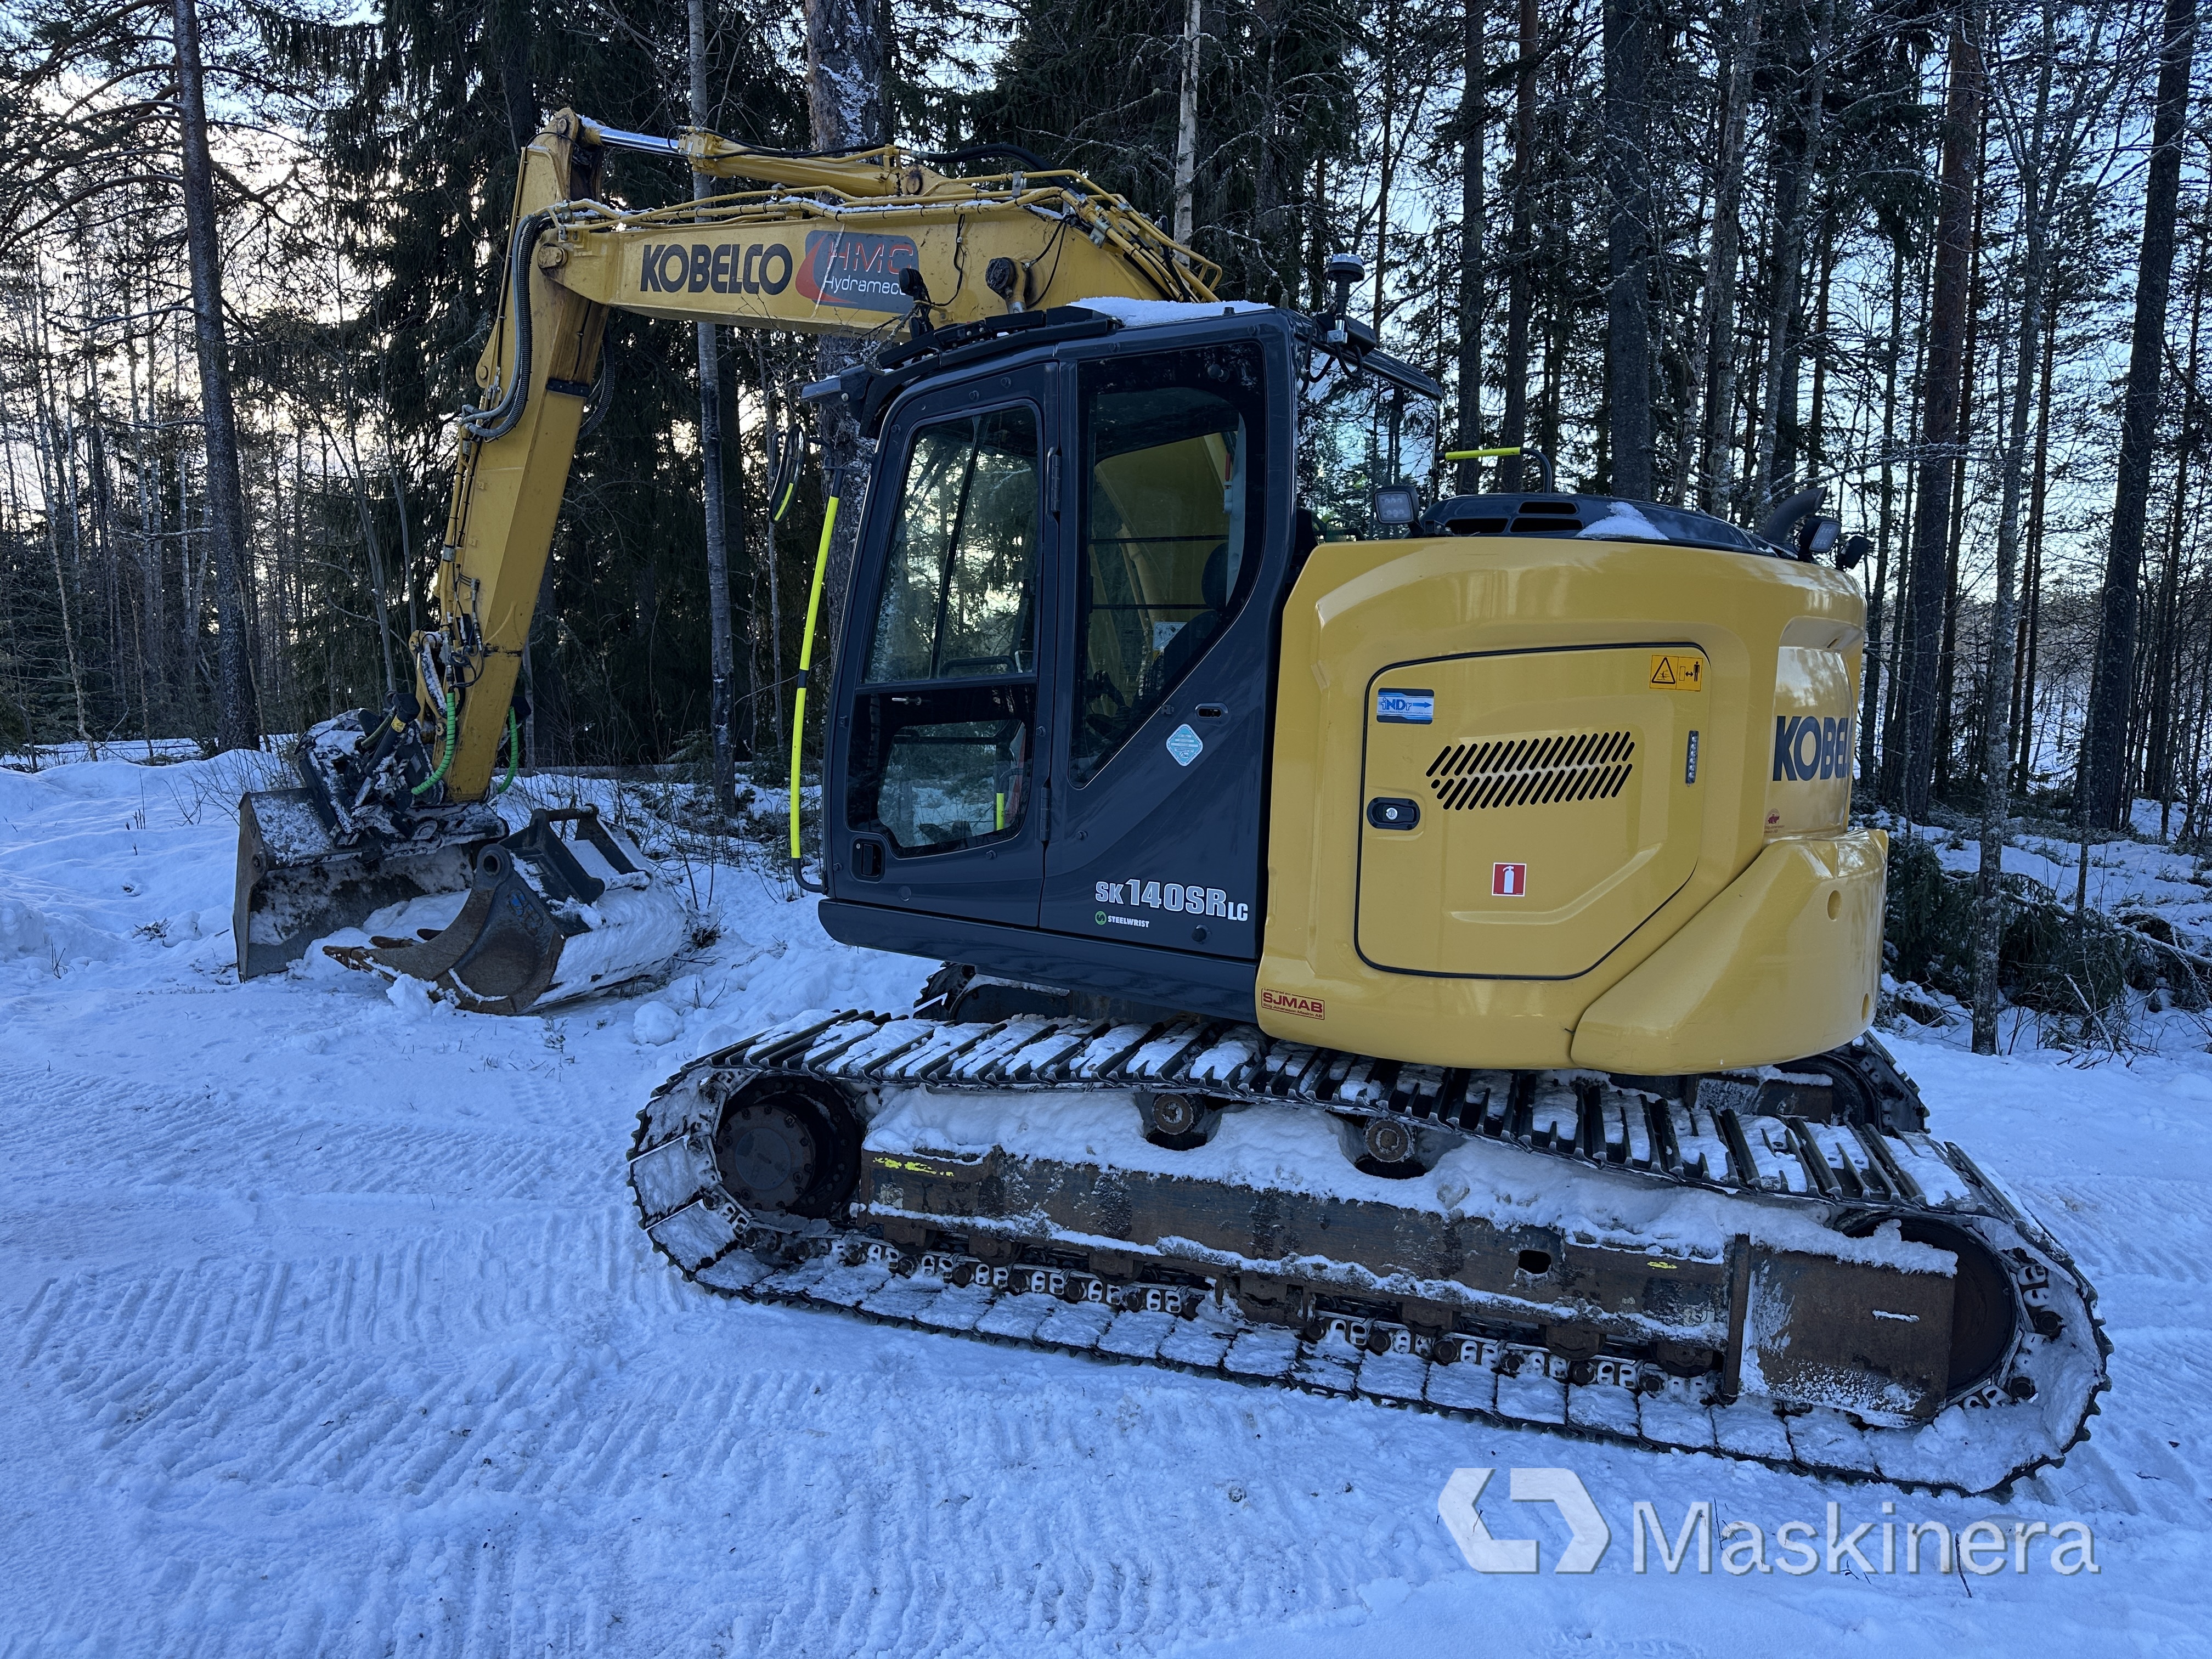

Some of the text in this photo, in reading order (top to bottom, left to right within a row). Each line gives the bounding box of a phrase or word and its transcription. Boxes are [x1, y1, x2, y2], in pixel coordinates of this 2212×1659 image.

[640, 243, 793, 295] KOBELCO
[824, 274, 906, 296] Hydramec
[1108, 915, 1150, 928] STEELWRIST
[1263, 992, 1323, 1013] SJMAB
